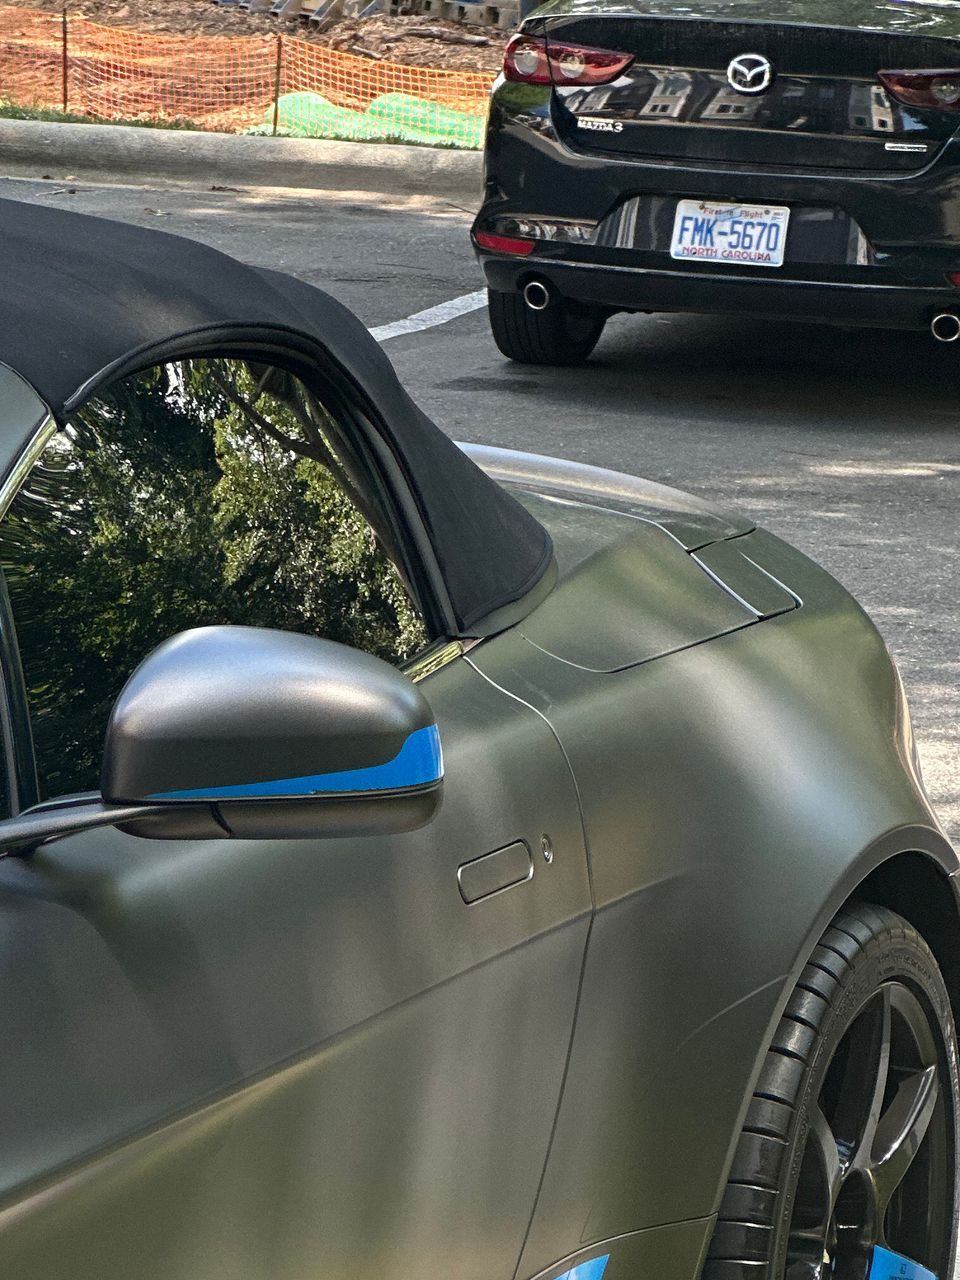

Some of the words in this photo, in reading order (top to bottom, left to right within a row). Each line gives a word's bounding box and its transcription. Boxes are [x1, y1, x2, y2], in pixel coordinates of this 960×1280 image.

[678, 216, 780, 251] FMK-5670
[682, 246, 718, 257] NORTH
[721, 249, 771, 261] CAROLINA
